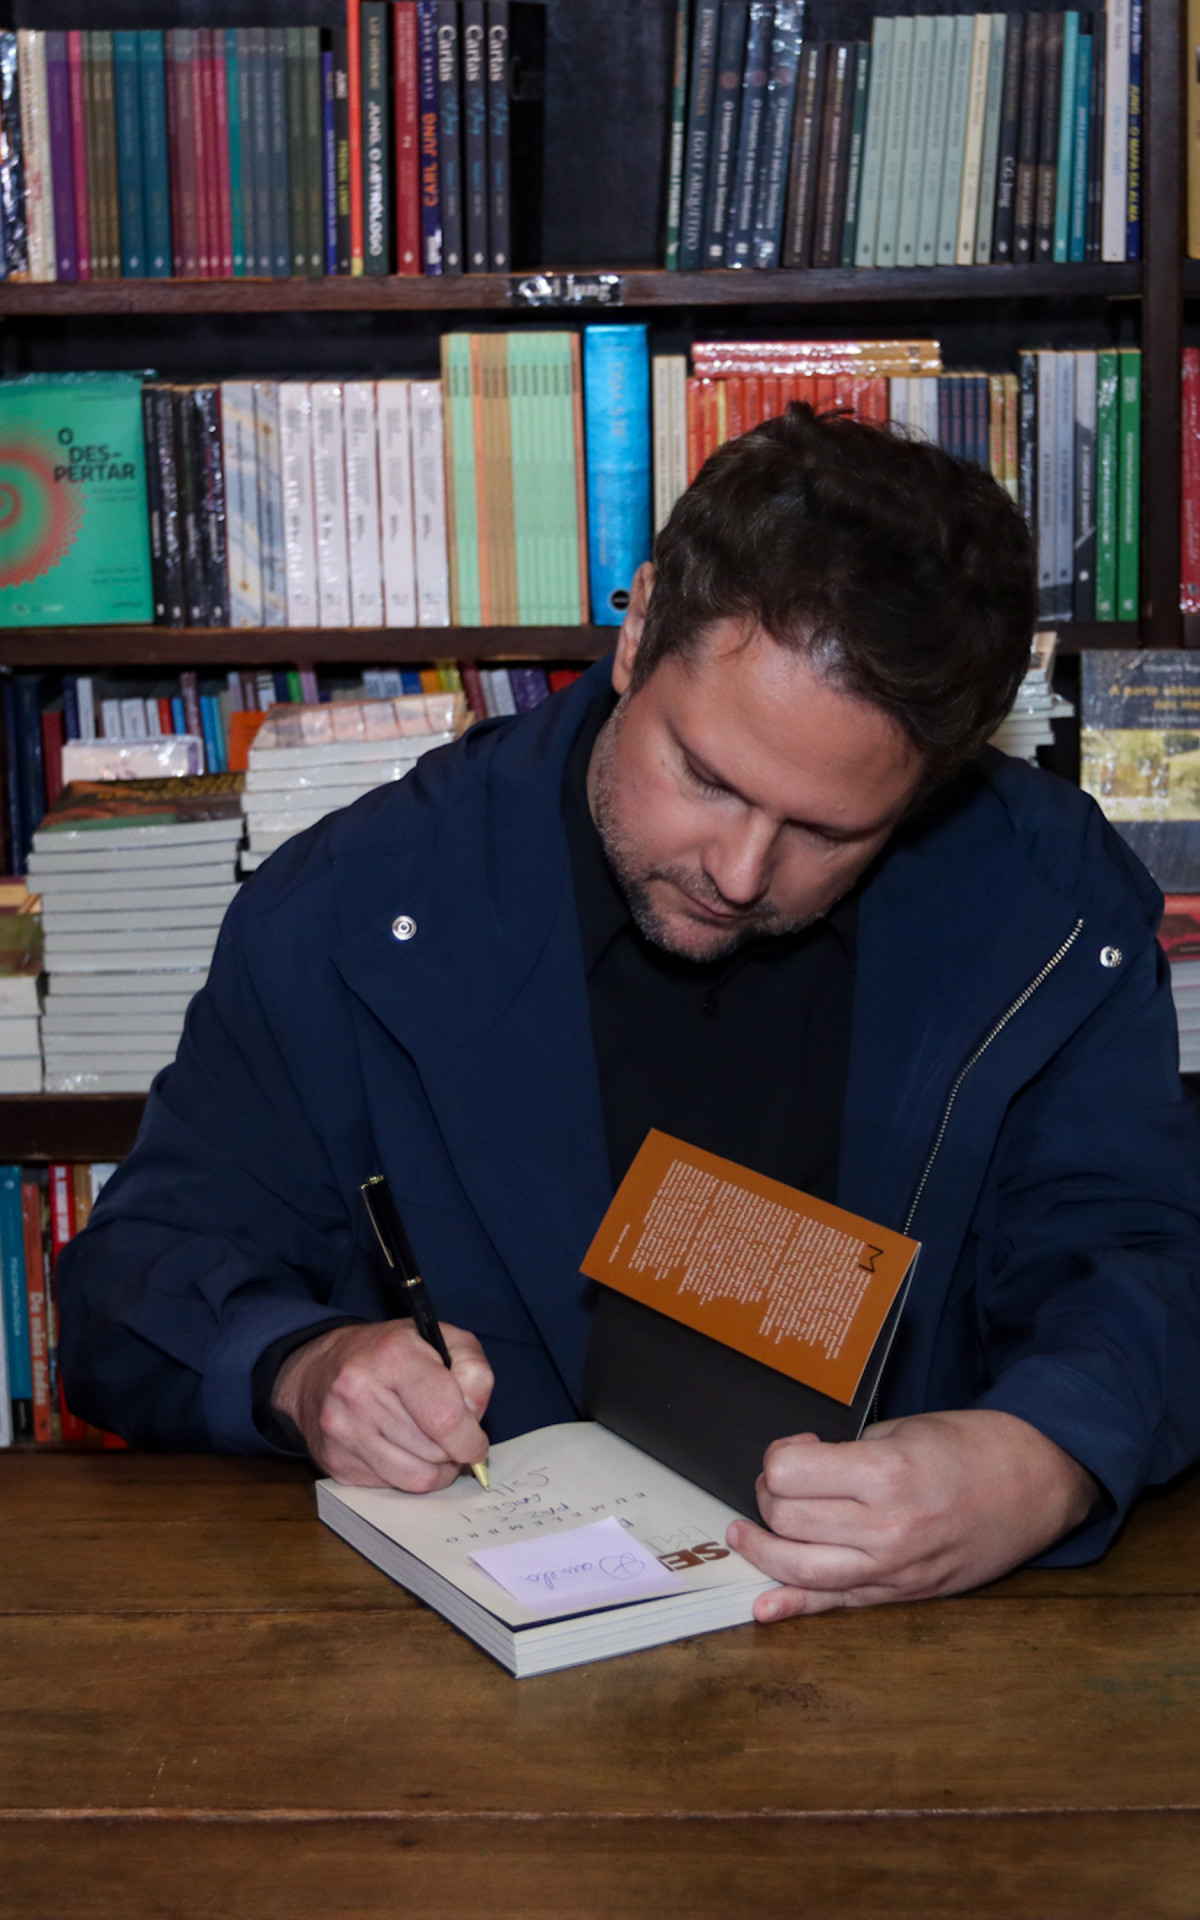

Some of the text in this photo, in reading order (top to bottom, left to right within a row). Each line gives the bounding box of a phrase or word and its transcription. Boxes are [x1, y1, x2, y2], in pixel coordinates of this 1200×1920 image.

[438, 24, 457, 82] Cartas
[465, 24, 484, 82] Cartas
[488, 24, 507, 82] Cartas
[723, 101, 733, 110] O
[751, 99, 761, 108] O
[778, 98, 788, 106] O
[1129, 84, 1140, 116] JUNG
[368, 148, 380, 160] O
[692, 130, 706, 159] EGO
[1128, 137, 1139, 170] MAPA
[422, 112, 438, 207] CARL JUNG
[1128, 171, 1139, 189] DA
[368, 164, 384, 256] ASTRÓLOGO
[998, 183, 1014, 208] Jung
[1128, 191, 1138, 223] ALMA
[58, 427, 74, 445] O
[69, 445, 122, 463] DES-
[53, 464, 136, 482] PERTAR
[29, 1292, 48, 1406] De mãos dadas
